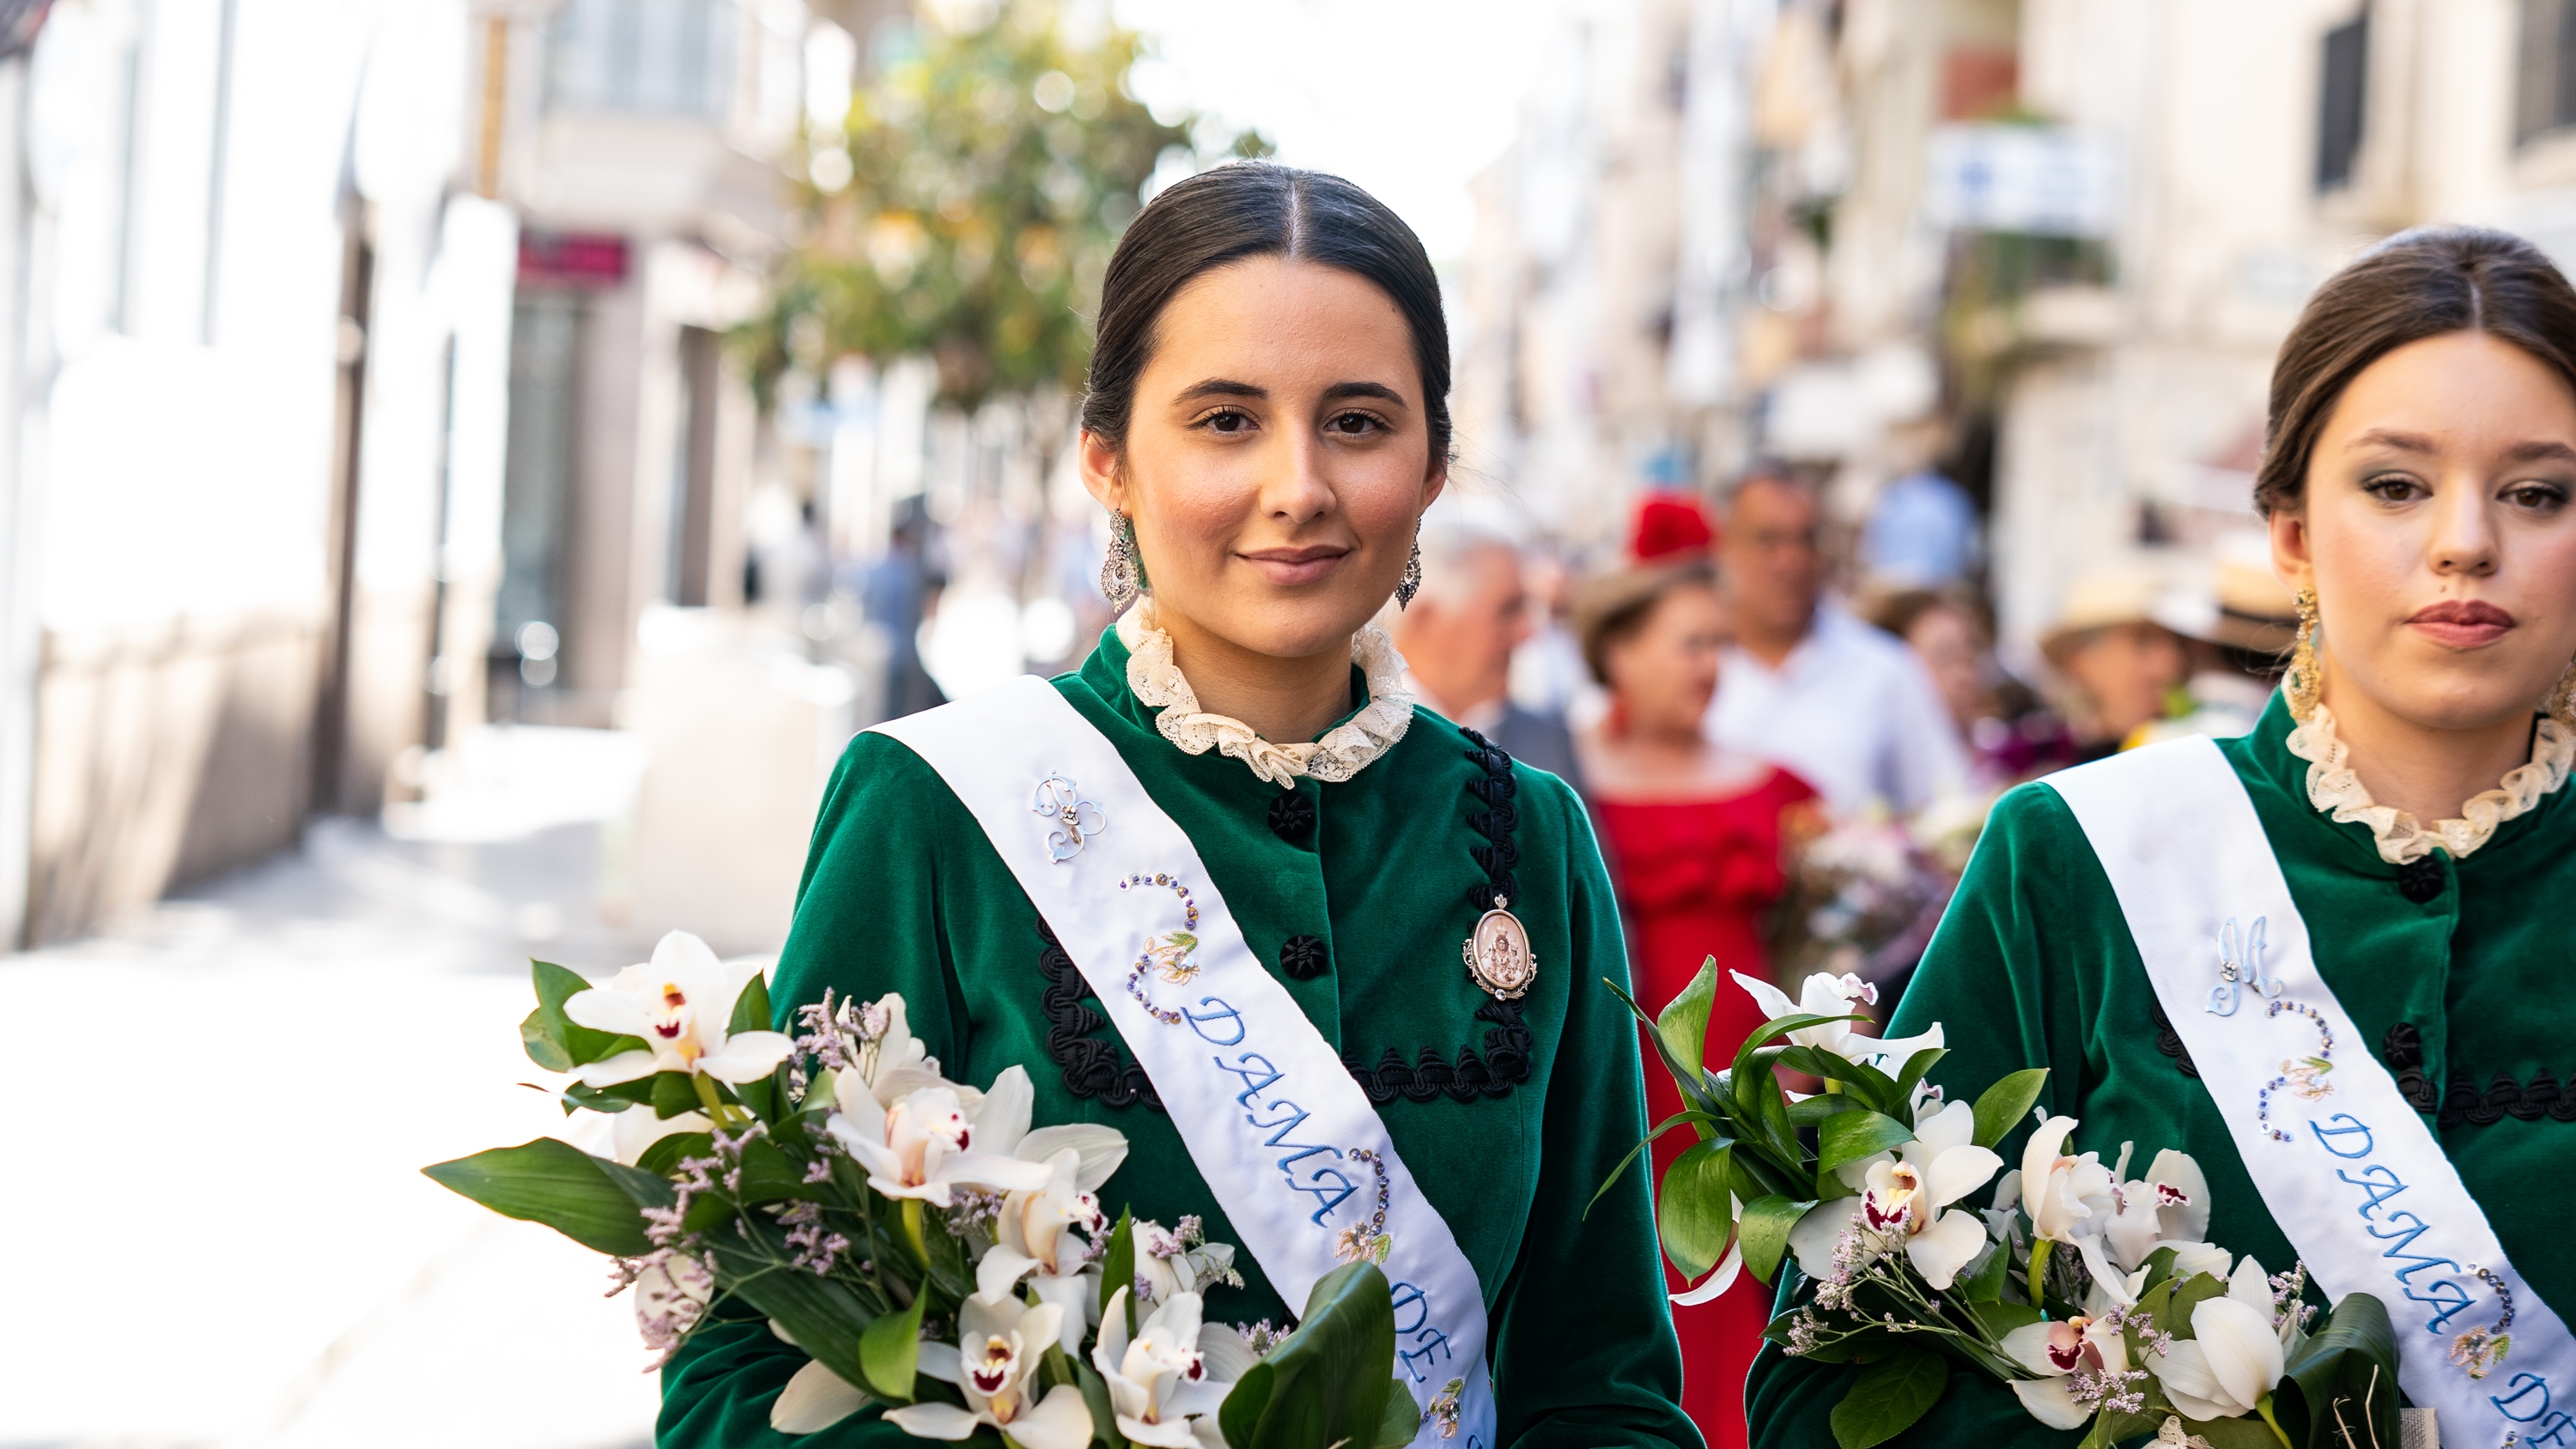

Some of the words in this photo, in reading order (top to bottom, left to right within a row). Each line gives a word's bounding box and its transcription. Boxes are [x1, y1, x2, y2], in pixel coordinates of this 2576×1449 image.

[2204, 916, 2283, 1016] M
[1180, 996, 1359, 1228] DAMA
[2308, 1113, 2477, 1335] DAMA
